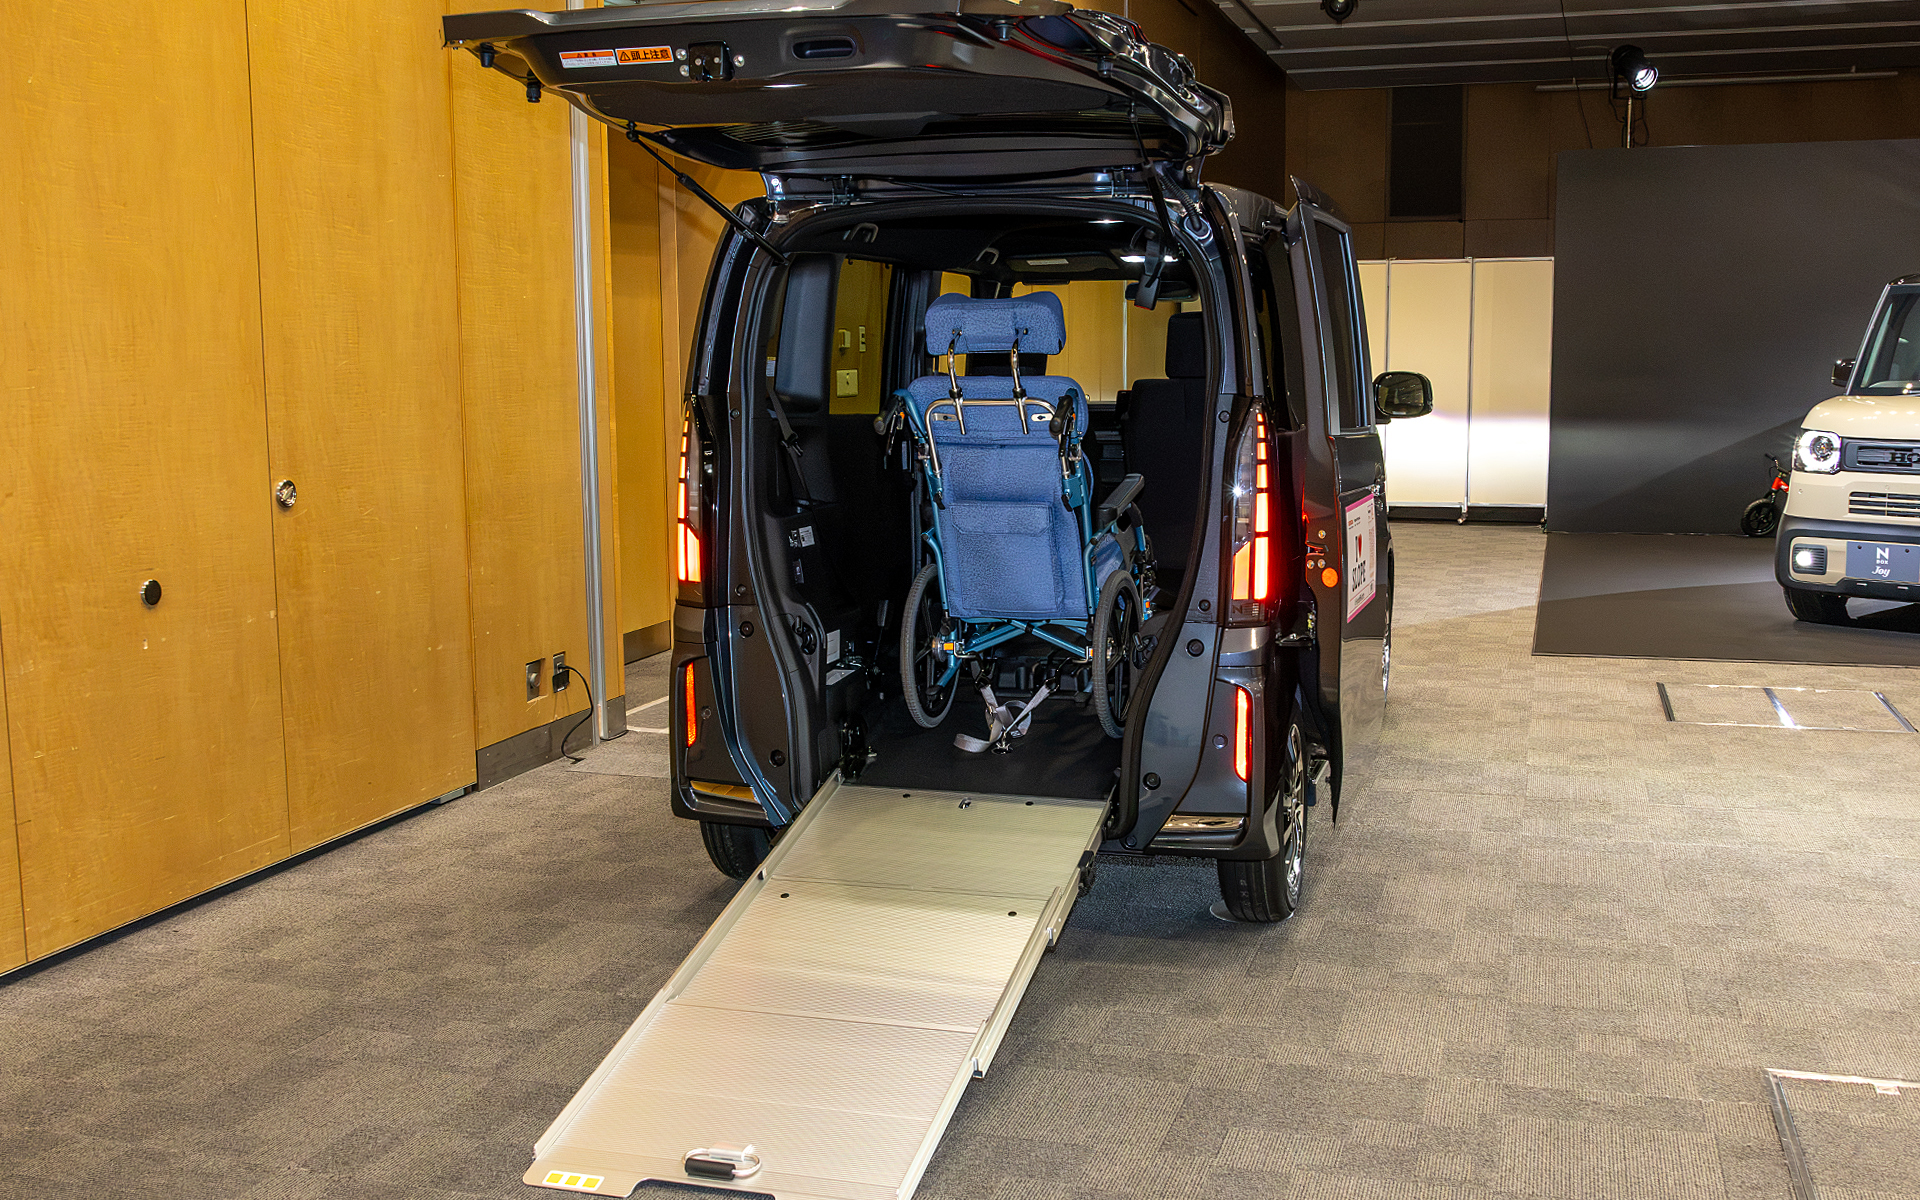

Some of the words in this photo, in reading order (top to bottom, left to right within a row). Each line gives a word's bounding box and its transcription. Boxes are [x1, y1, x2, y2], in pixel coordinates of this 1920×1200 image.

[630, 49, 671, 61] 頭上注意
[1876, 547, 1889, 559] N
[1871, 565, 1890, 577] Joy
